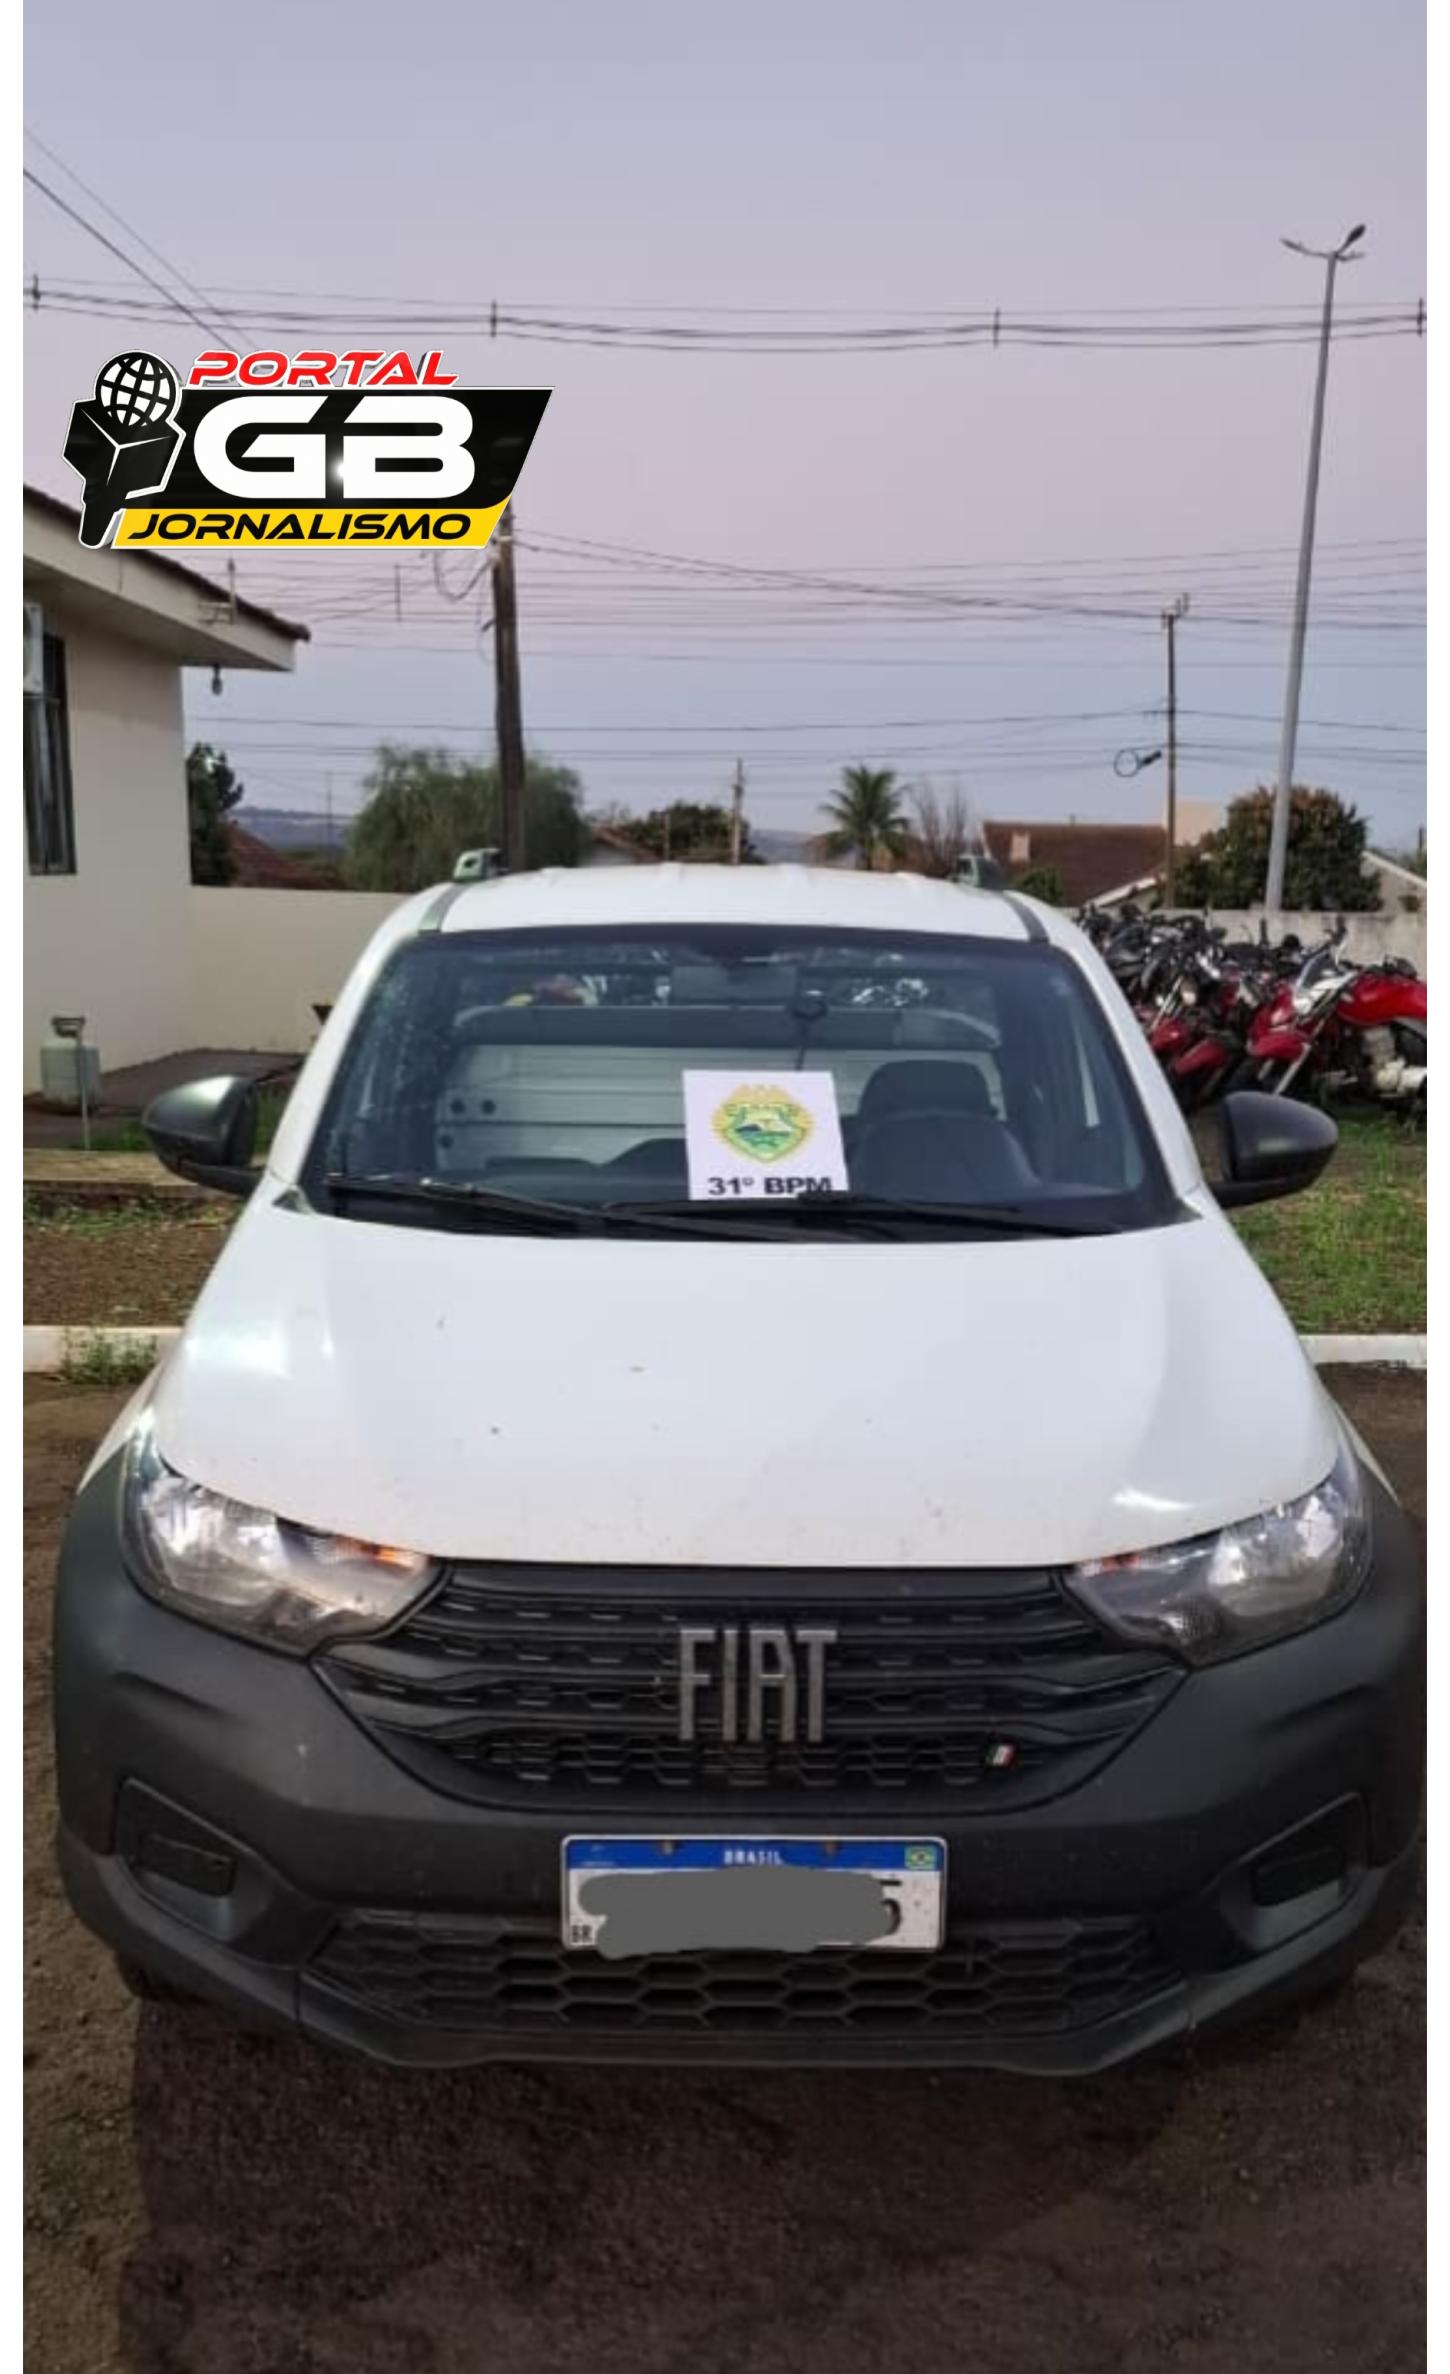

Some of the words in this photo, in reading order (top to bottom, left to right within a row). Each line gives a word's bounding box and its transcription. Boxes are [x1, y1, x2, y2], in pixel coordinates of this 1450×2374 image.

[763, 1176, 832, 1195] BPM
[678, 1628, 838, 1742] FIAT
[723, 1849, 784, 1865] BRASIL
